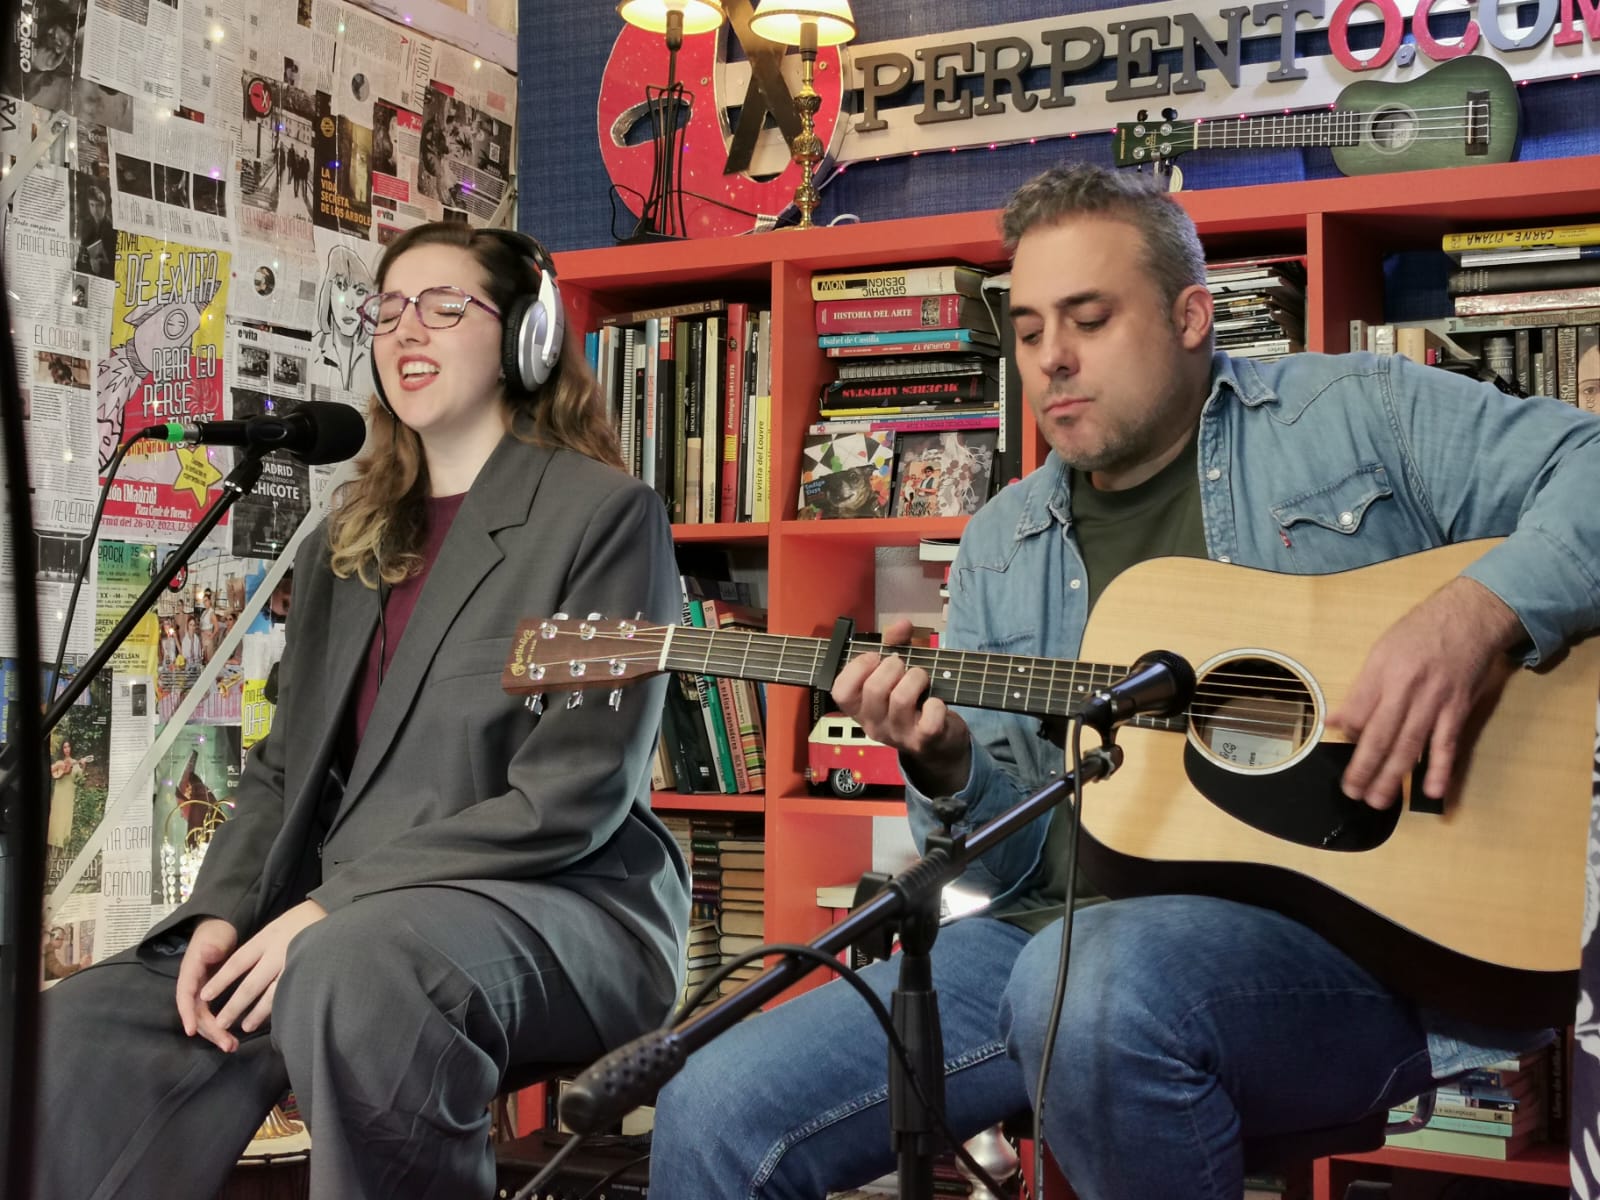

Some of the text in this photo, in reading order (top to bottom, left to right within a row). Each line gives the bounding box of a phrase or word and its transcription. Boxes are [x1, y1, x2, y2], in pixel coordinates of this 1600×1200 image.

[321, 168, 331, 179] LA
[320, 192, 350, 208] SECRETA
[321, 203, 331, 214] DE
[332, 206, 345, 218] LOS
[1466, 232, 1505, 246] PIJAMA
[1514, 229, 1555, 242] CARNE
[16, 233, 47, 256] DANIEL
[124, 253, 153, 308] DE
[820, 276, 906, 291] DESIGN NOW
[862, 286, 907, 298] GRAPHIC
[833, 308, 913, 320] HISTORIA DEL ARTE
[152, 347, 193, 382] DEAR
[842, 382, 960, 398] MUJERES ARTISTAS
[142, 383, 192, 418] PERSE
[758, 420, 766, 451] Louvre
[756, 491, 762, 503] su
[103, 870, 152, 897] CAMINO
